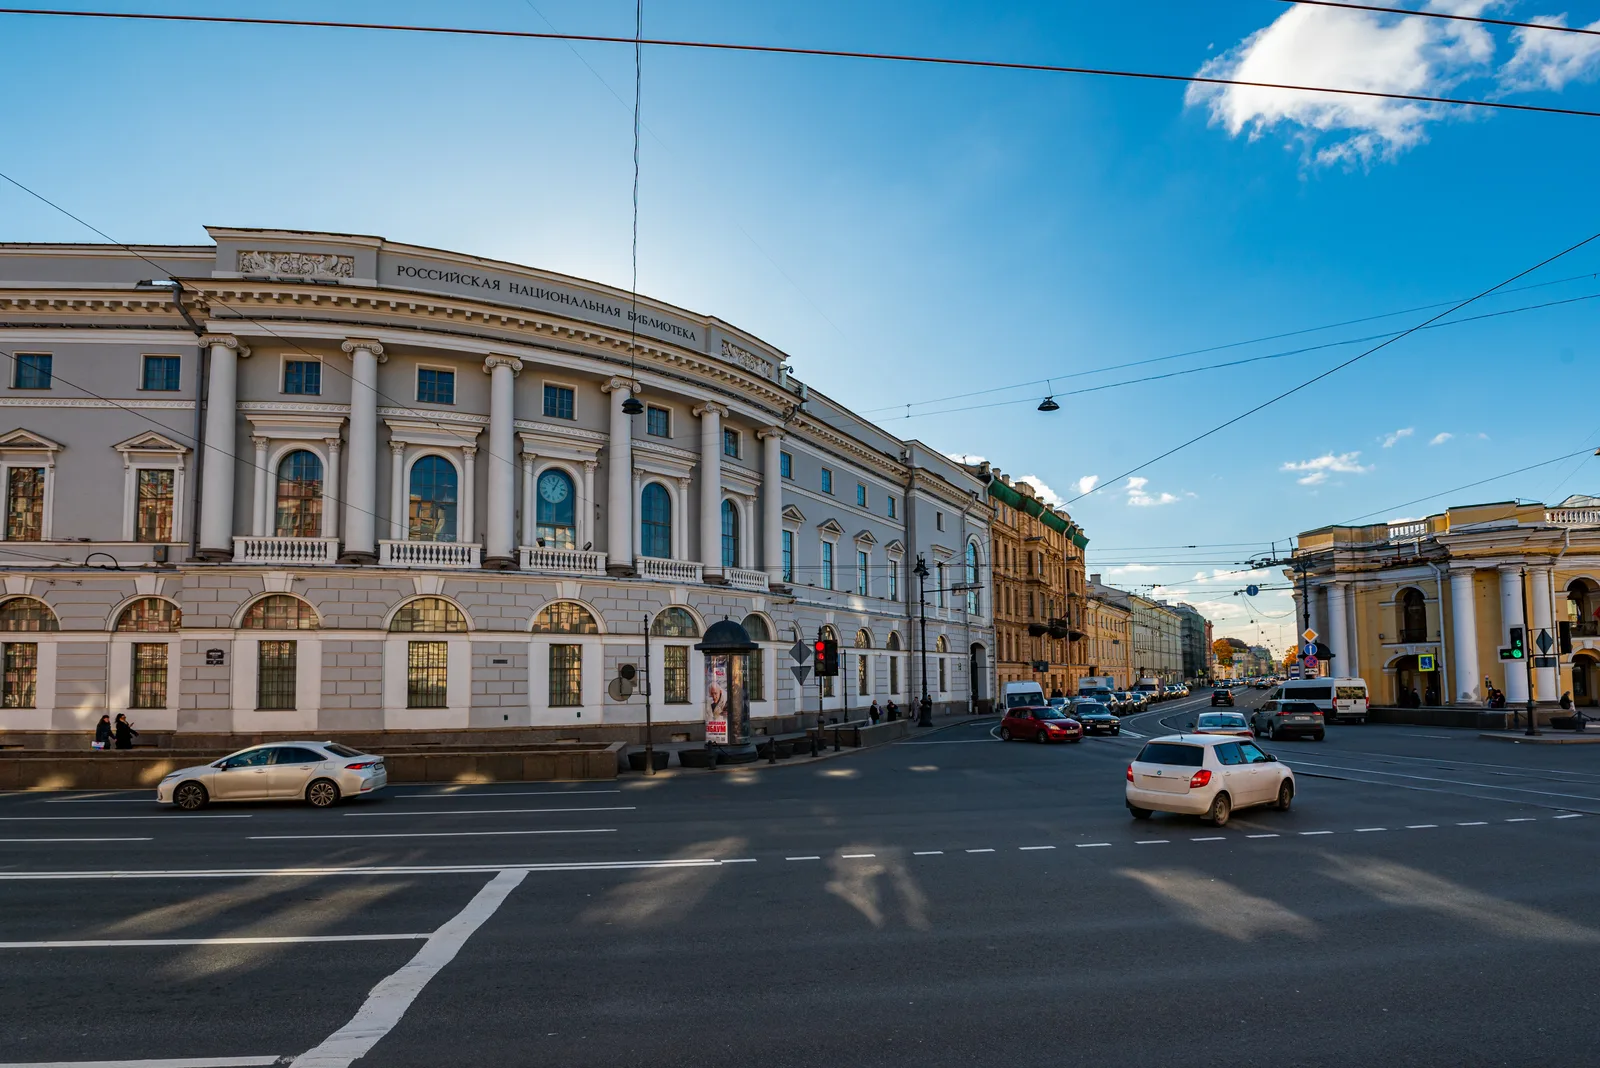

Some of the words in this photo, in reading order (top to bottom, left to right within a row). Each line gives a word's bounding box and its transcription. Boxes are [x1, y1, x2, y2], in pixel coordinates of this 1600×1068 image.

[397, 265, 501, 290] РОССИЙСКАЯ
[509, 282, 621, 318] НАЦИОНАЛЬНАЯ
[627, 311, 697, 342] БИБЛИОТЕКА
